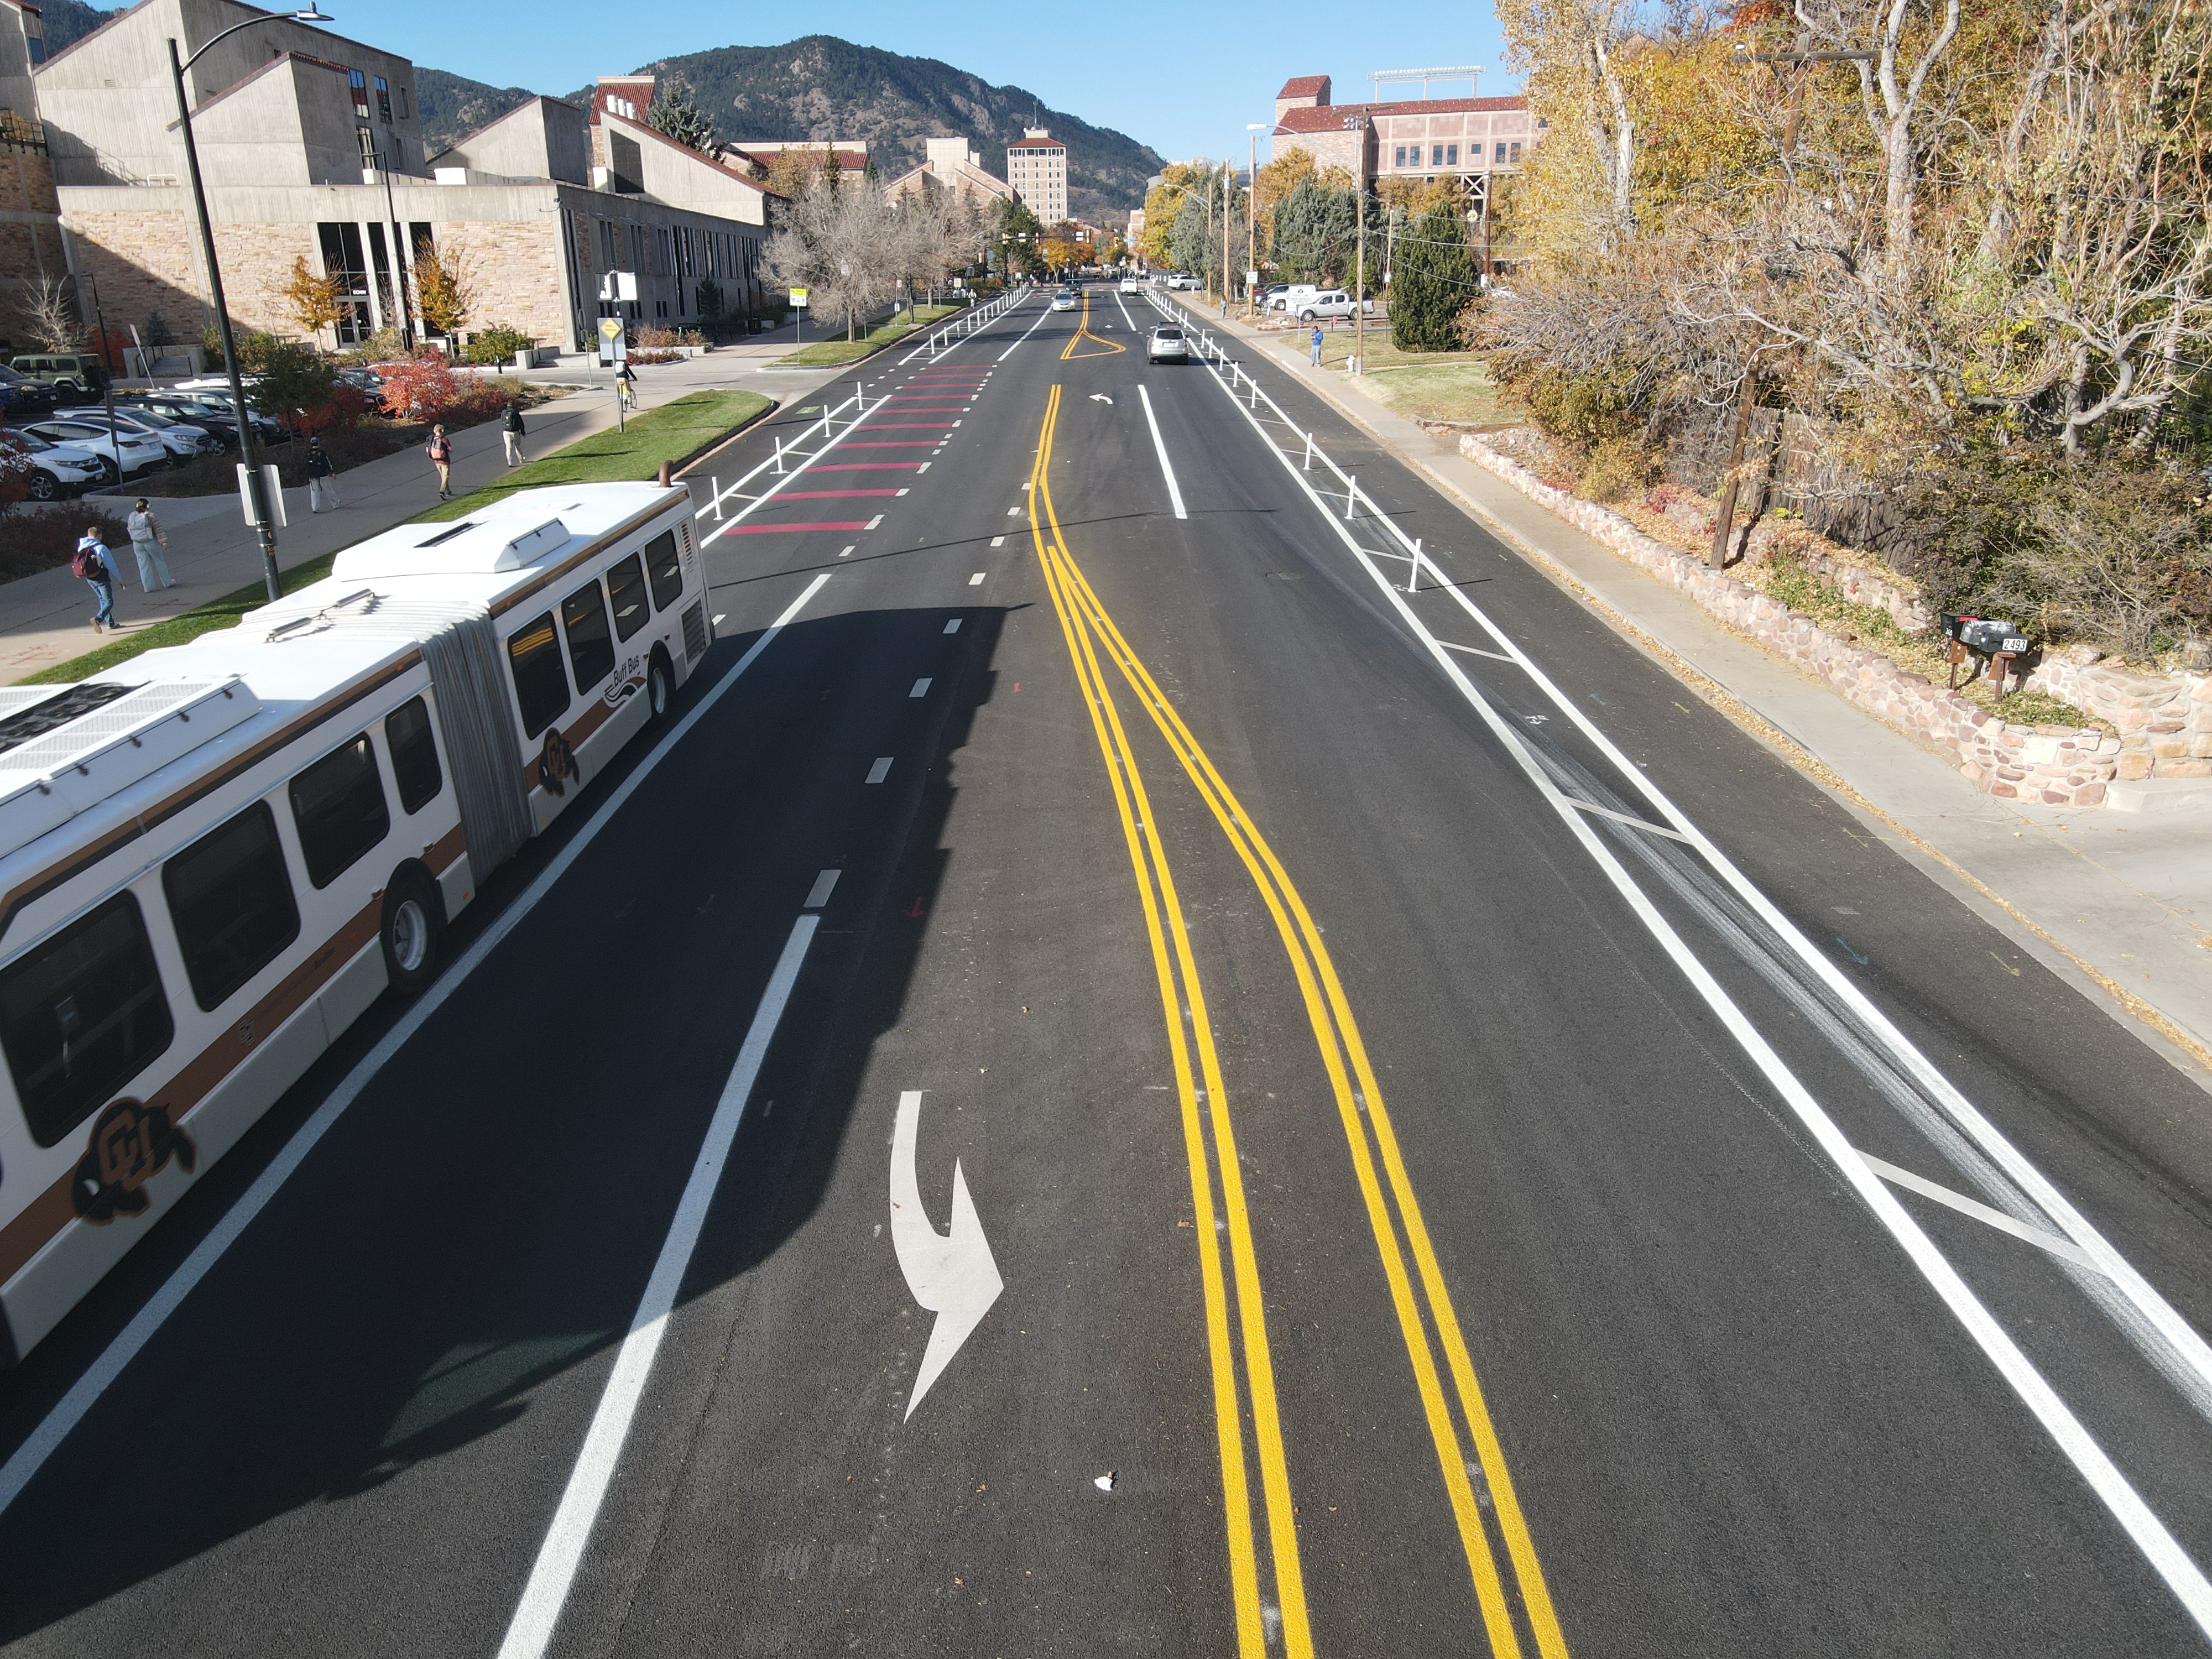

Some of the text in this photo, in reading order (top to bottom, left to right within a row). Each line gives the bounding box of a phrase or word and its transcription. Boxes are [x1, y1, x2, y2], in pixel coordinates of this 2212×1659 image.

[2004, 640, 2026, 650] 2493
[614, 655, 639, 686] Buff Bus
[98, 1108, 155, 1192] CU
